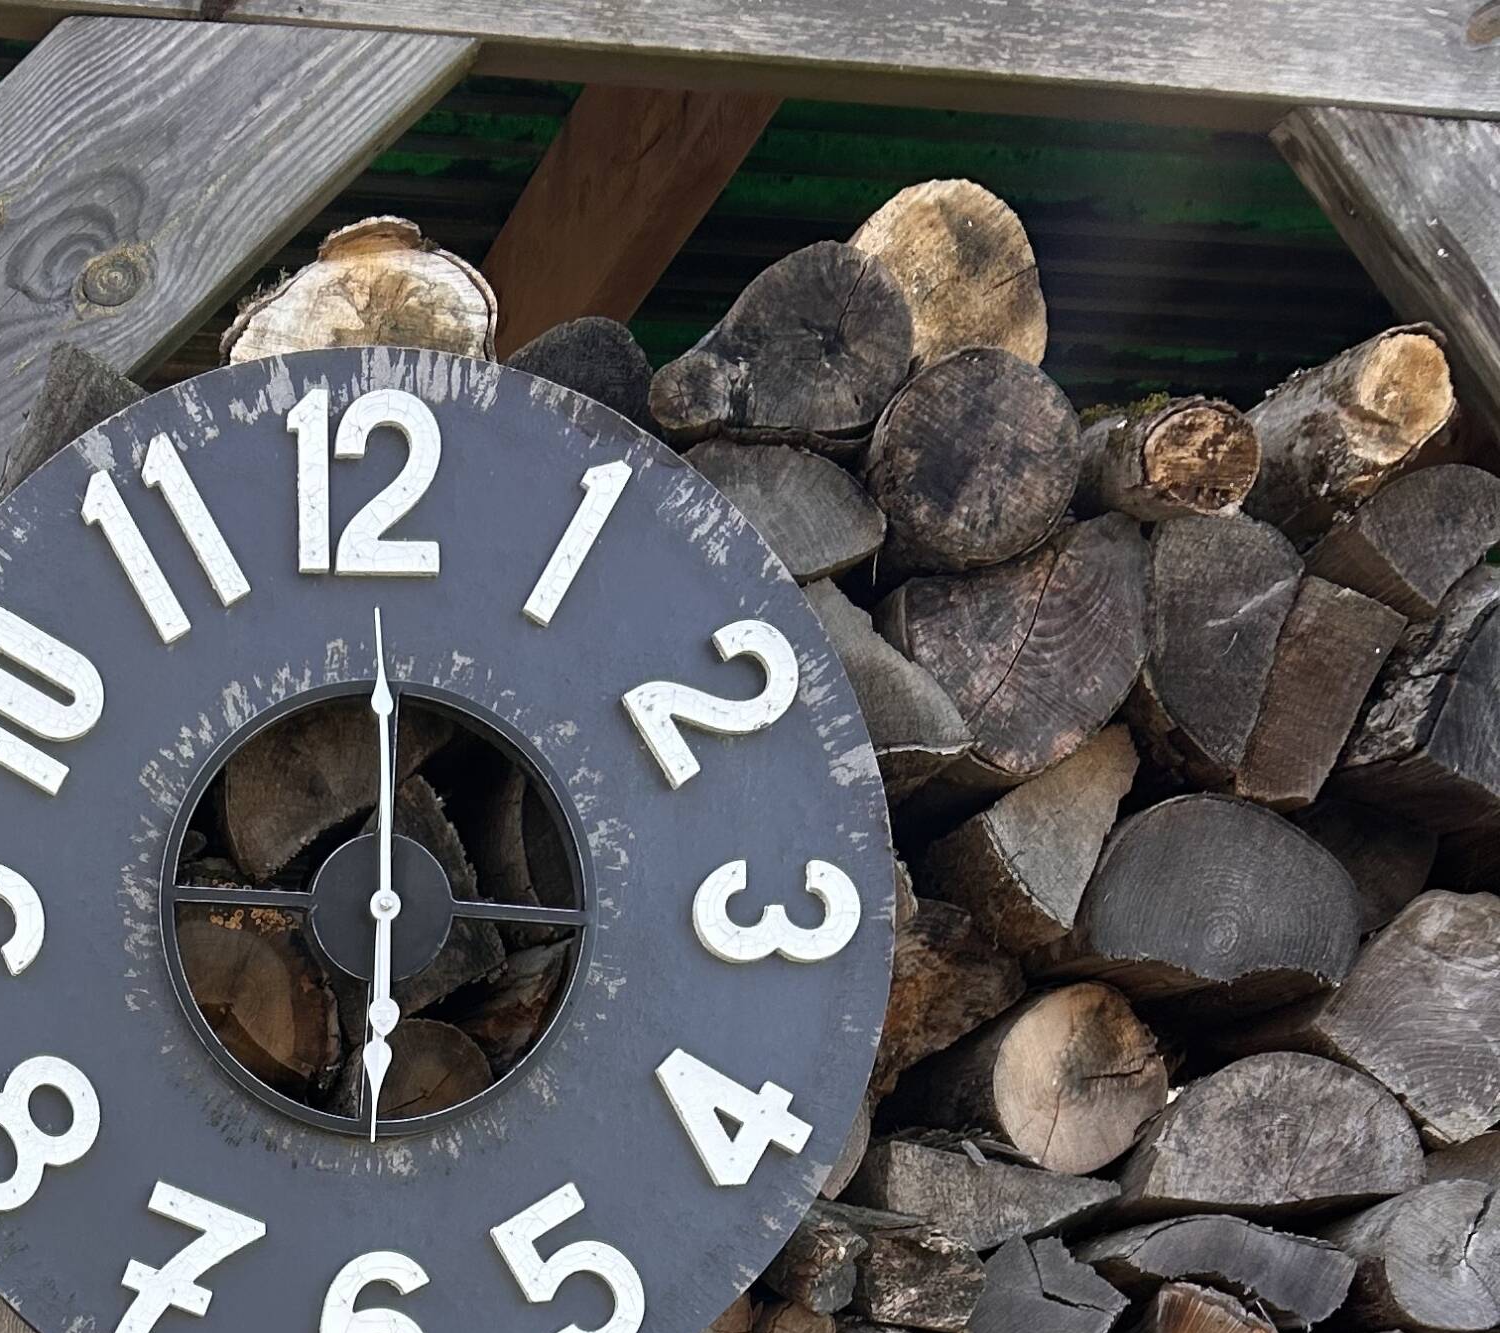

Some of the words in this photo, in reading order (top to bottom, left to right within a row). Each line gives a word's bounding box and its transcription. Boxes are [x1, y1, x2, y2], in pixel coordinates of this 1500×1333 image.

[80, 432, 251, 644] 11
[286, 388, 442, 577] 12
[523, 459, 633, 627] 1
[622, 619, 800, 790] 2
[692, 859, 861, 964] 3
[654, 1048, 814, 1187] 4
